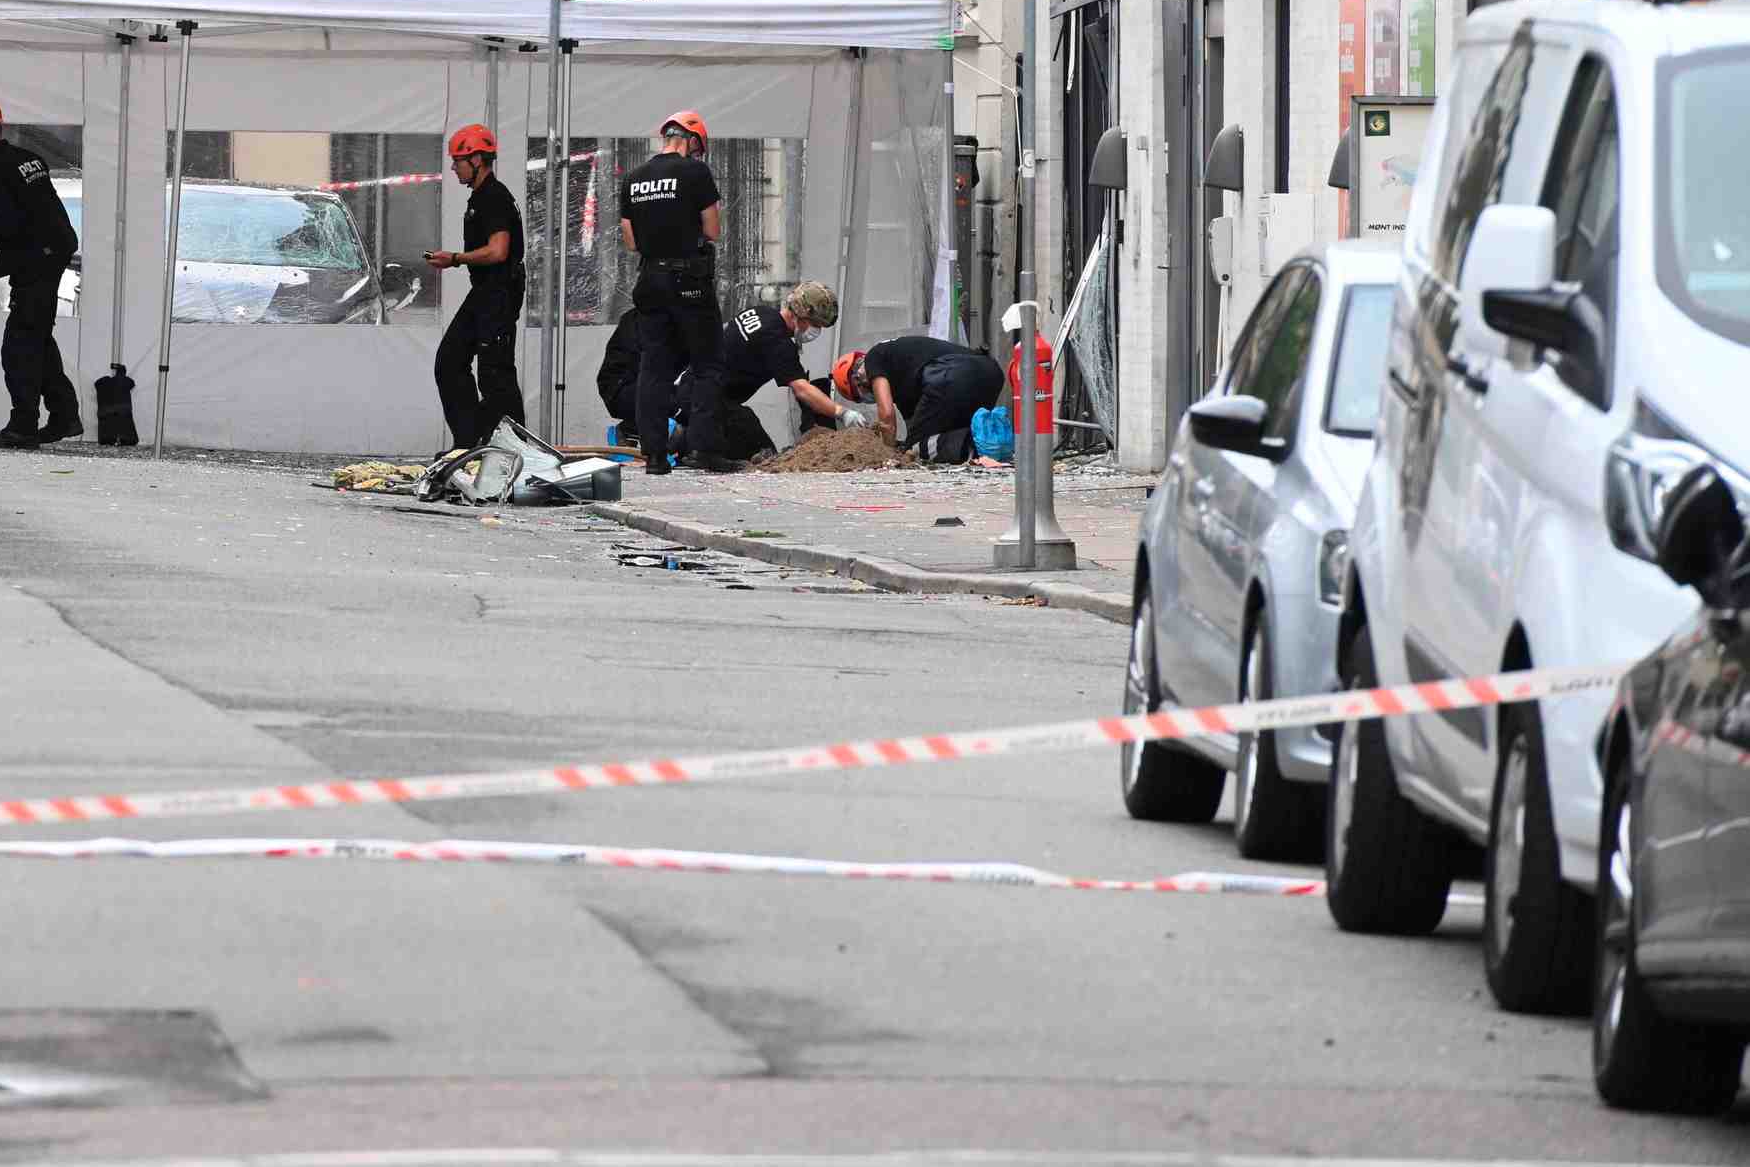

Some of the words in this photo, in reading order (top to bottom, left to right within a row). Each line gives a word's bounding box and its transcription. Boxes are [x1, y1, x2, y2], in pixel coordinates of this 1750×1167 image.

[18, 160, 44, 178] POLIT
[630, 178, 677, 196] POLITI
[738, 308, 763, 335] EOD
